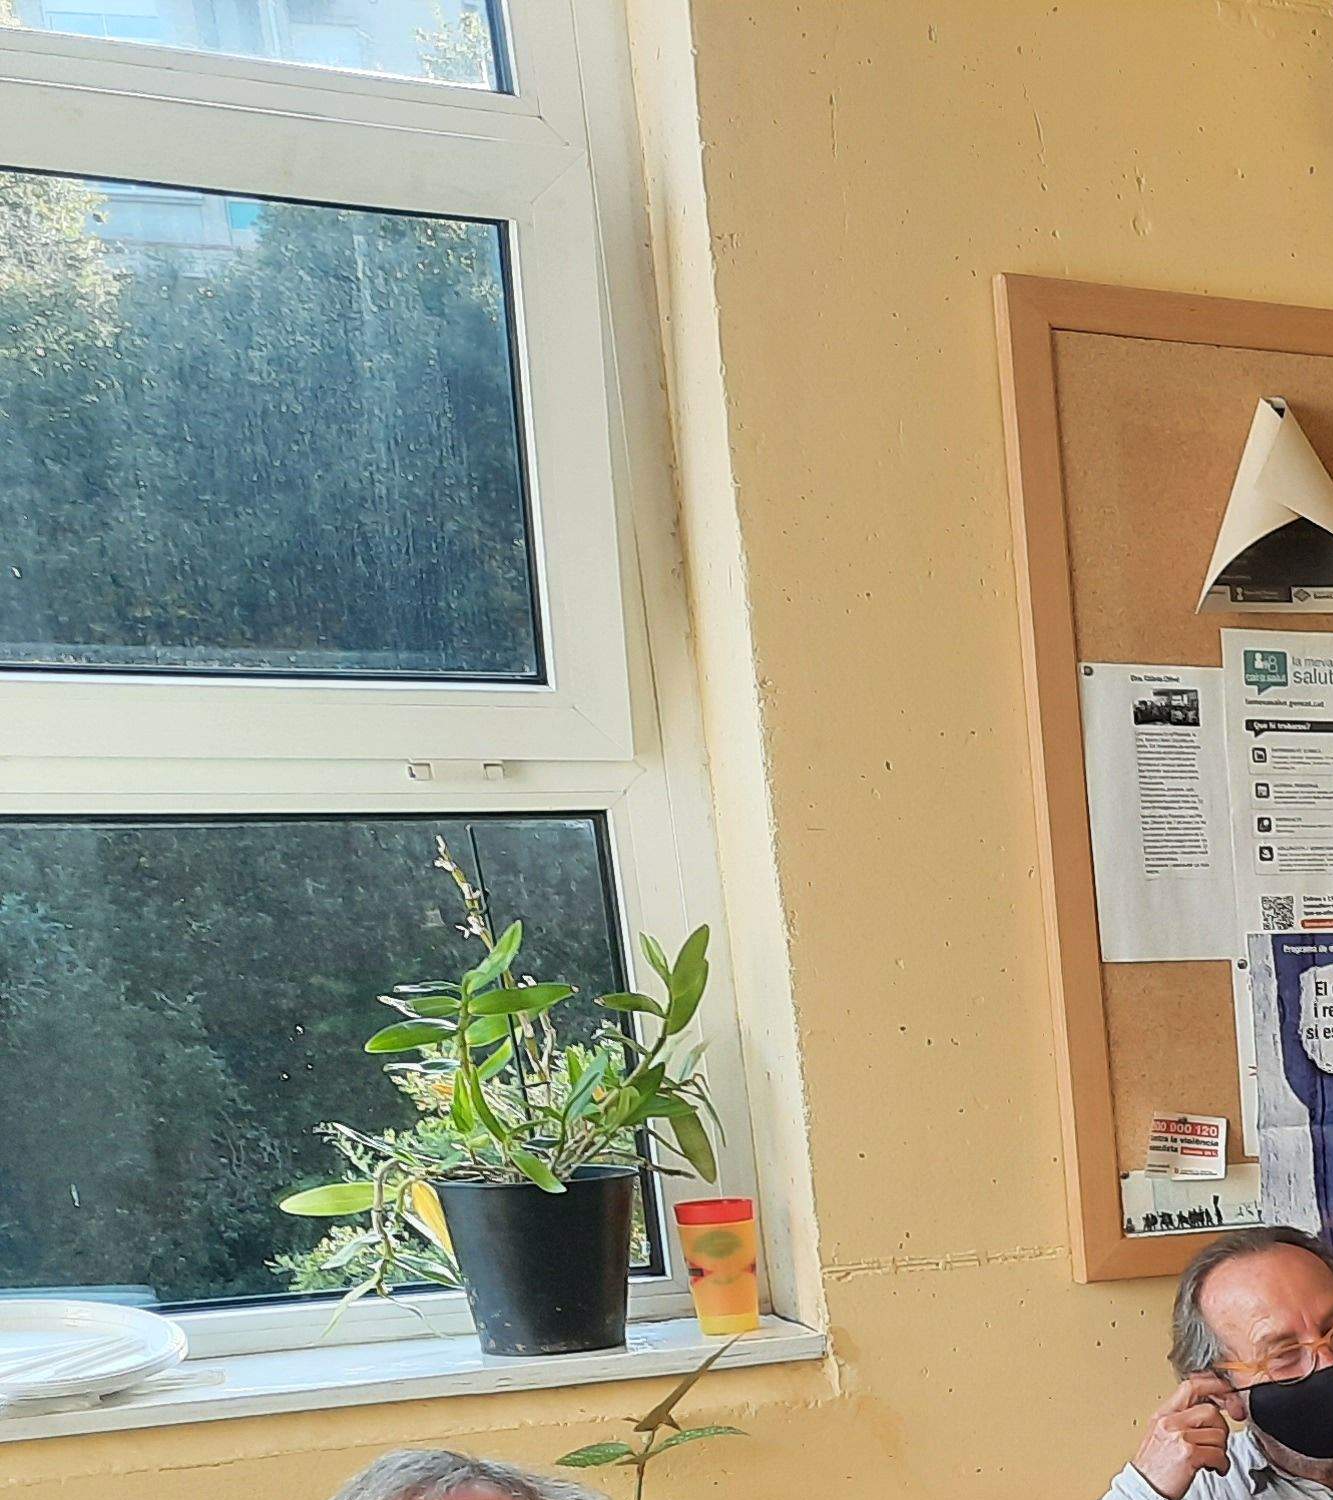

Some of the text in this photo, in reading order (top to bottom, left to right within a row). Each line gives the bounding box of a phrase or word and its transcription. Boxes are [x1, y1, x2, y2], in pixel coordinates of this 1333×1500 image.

[1293, 668, 1333, 685] salut
[1315, 982, 1327, 997] El
[1313, 1003, 1318, 1018] i
[1306, 1025, 1318, 1040] si
[1195, 1125, 1217, 1136] 120
